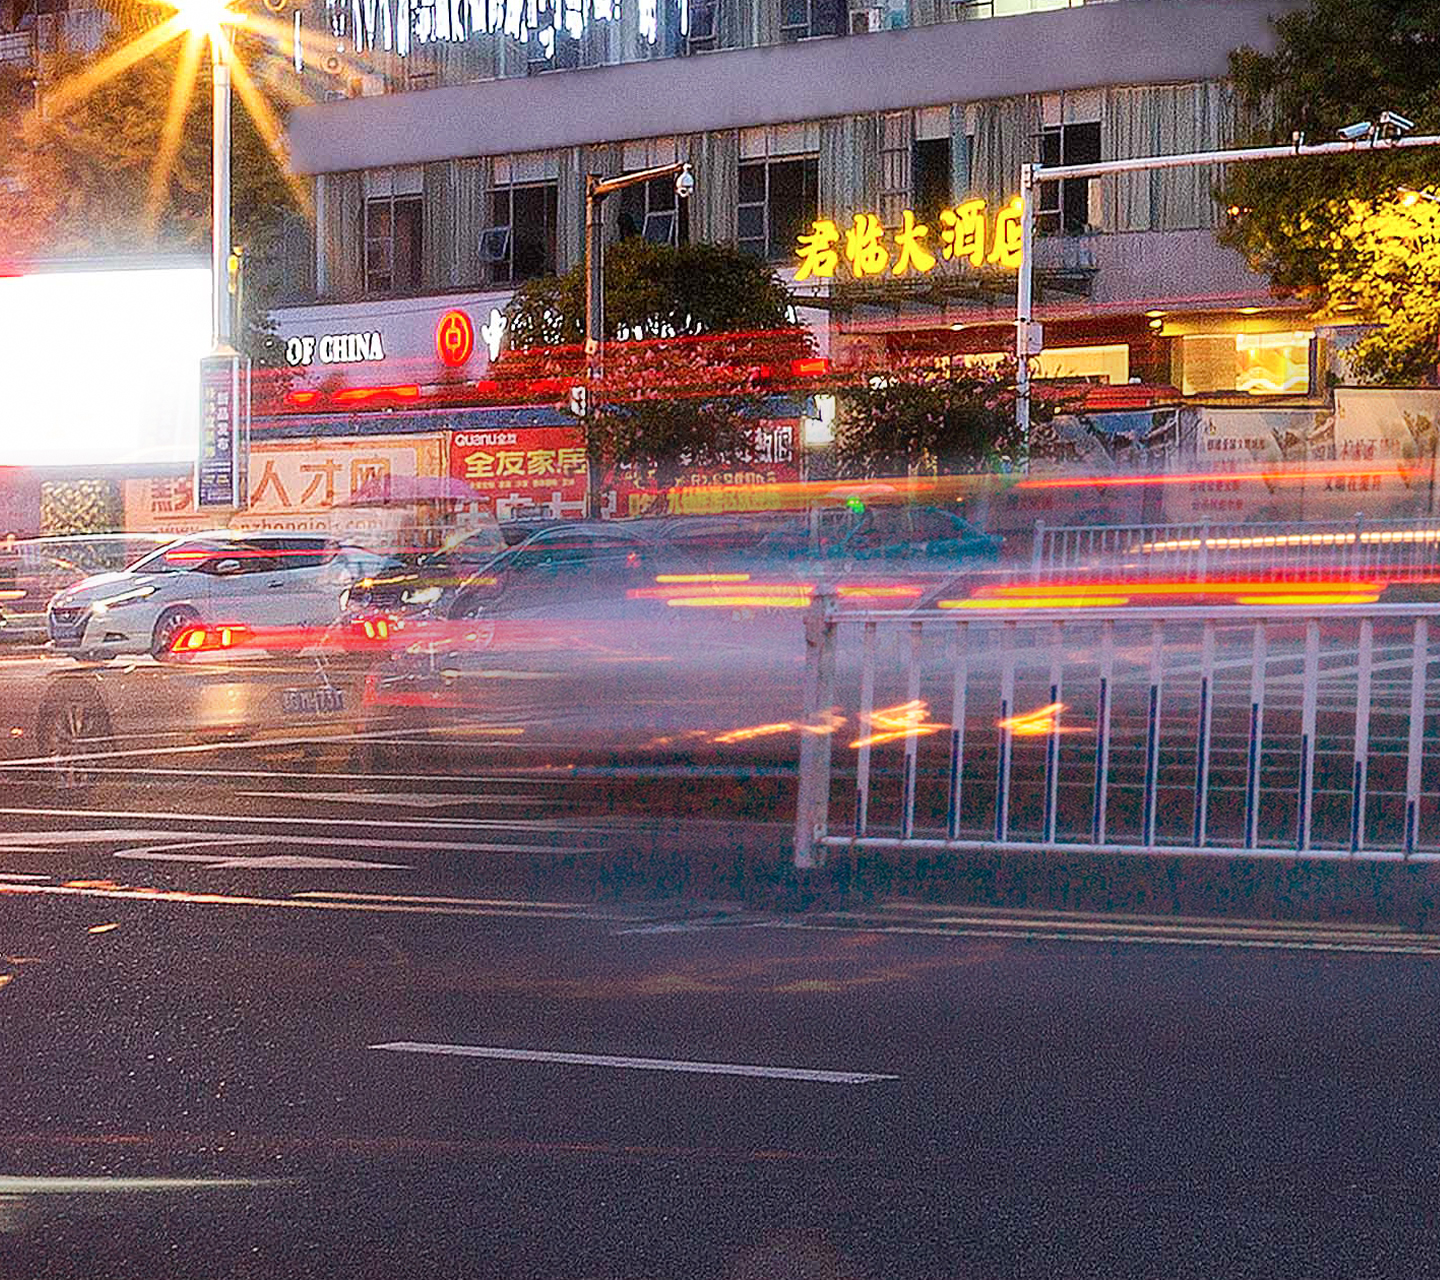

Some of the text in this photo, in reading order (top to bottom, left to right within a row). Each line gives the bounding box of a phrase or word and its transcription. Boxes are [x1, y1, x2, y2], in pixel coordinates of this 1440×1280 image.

[793, 196, 1024, 281] 君临大酒店
[286, 331, 385, 366] OF CHINA
[465, 447, 587, 478] 全友家居
